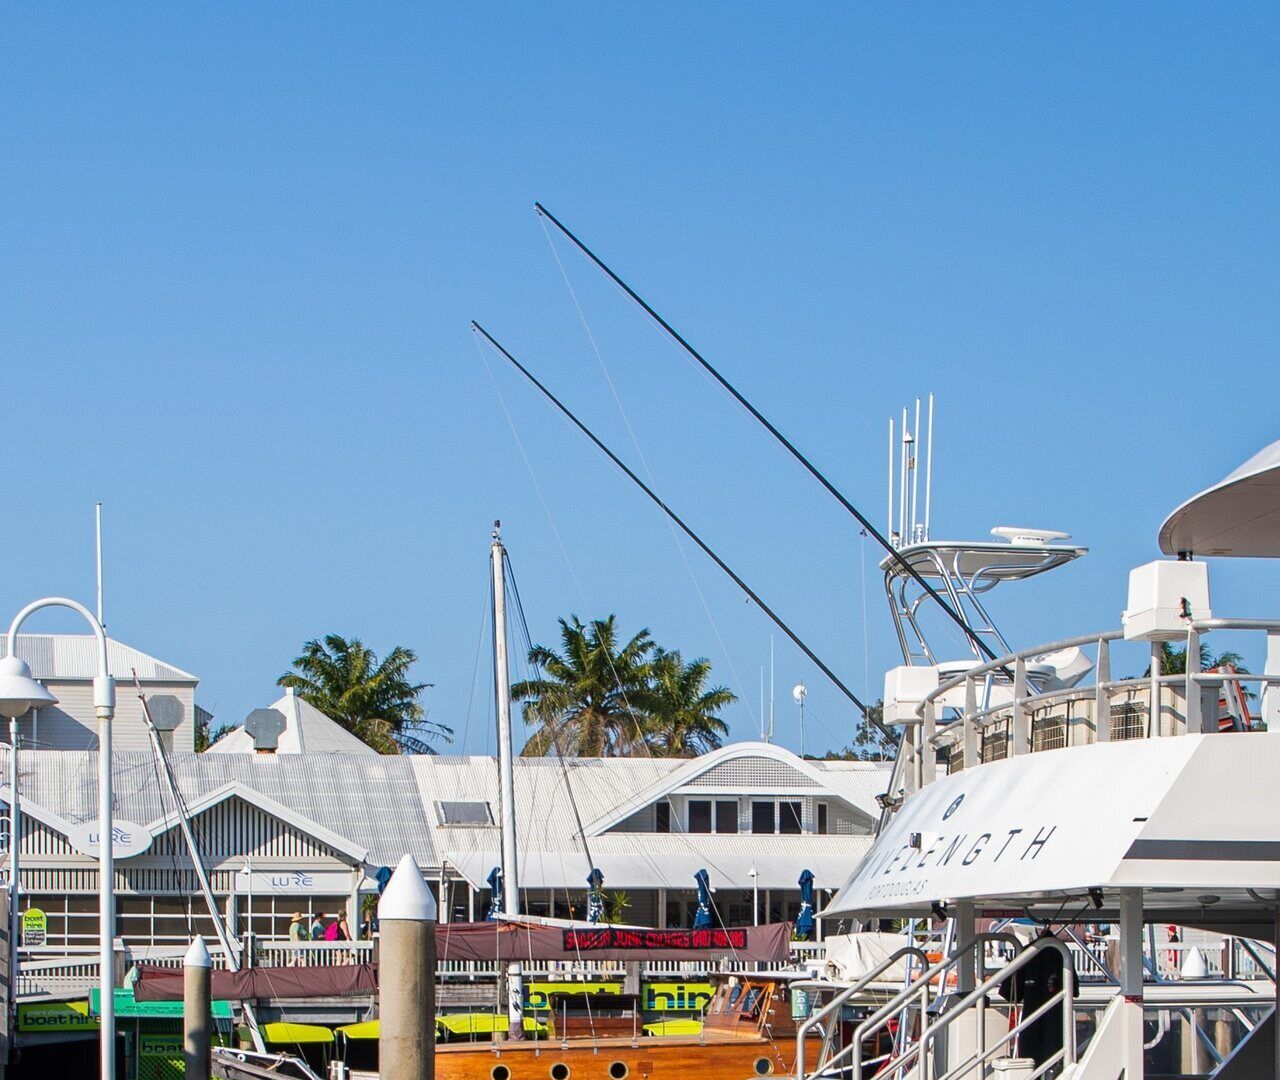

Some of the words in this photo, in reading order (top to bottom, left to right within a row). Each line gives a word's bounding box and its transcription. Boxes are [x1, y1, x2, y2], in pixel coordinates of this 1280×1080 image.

[89, 829, 131, 843] LRE
[272, 874, 313, 887] LURE
[23, 1014, 67, 1026] boat
